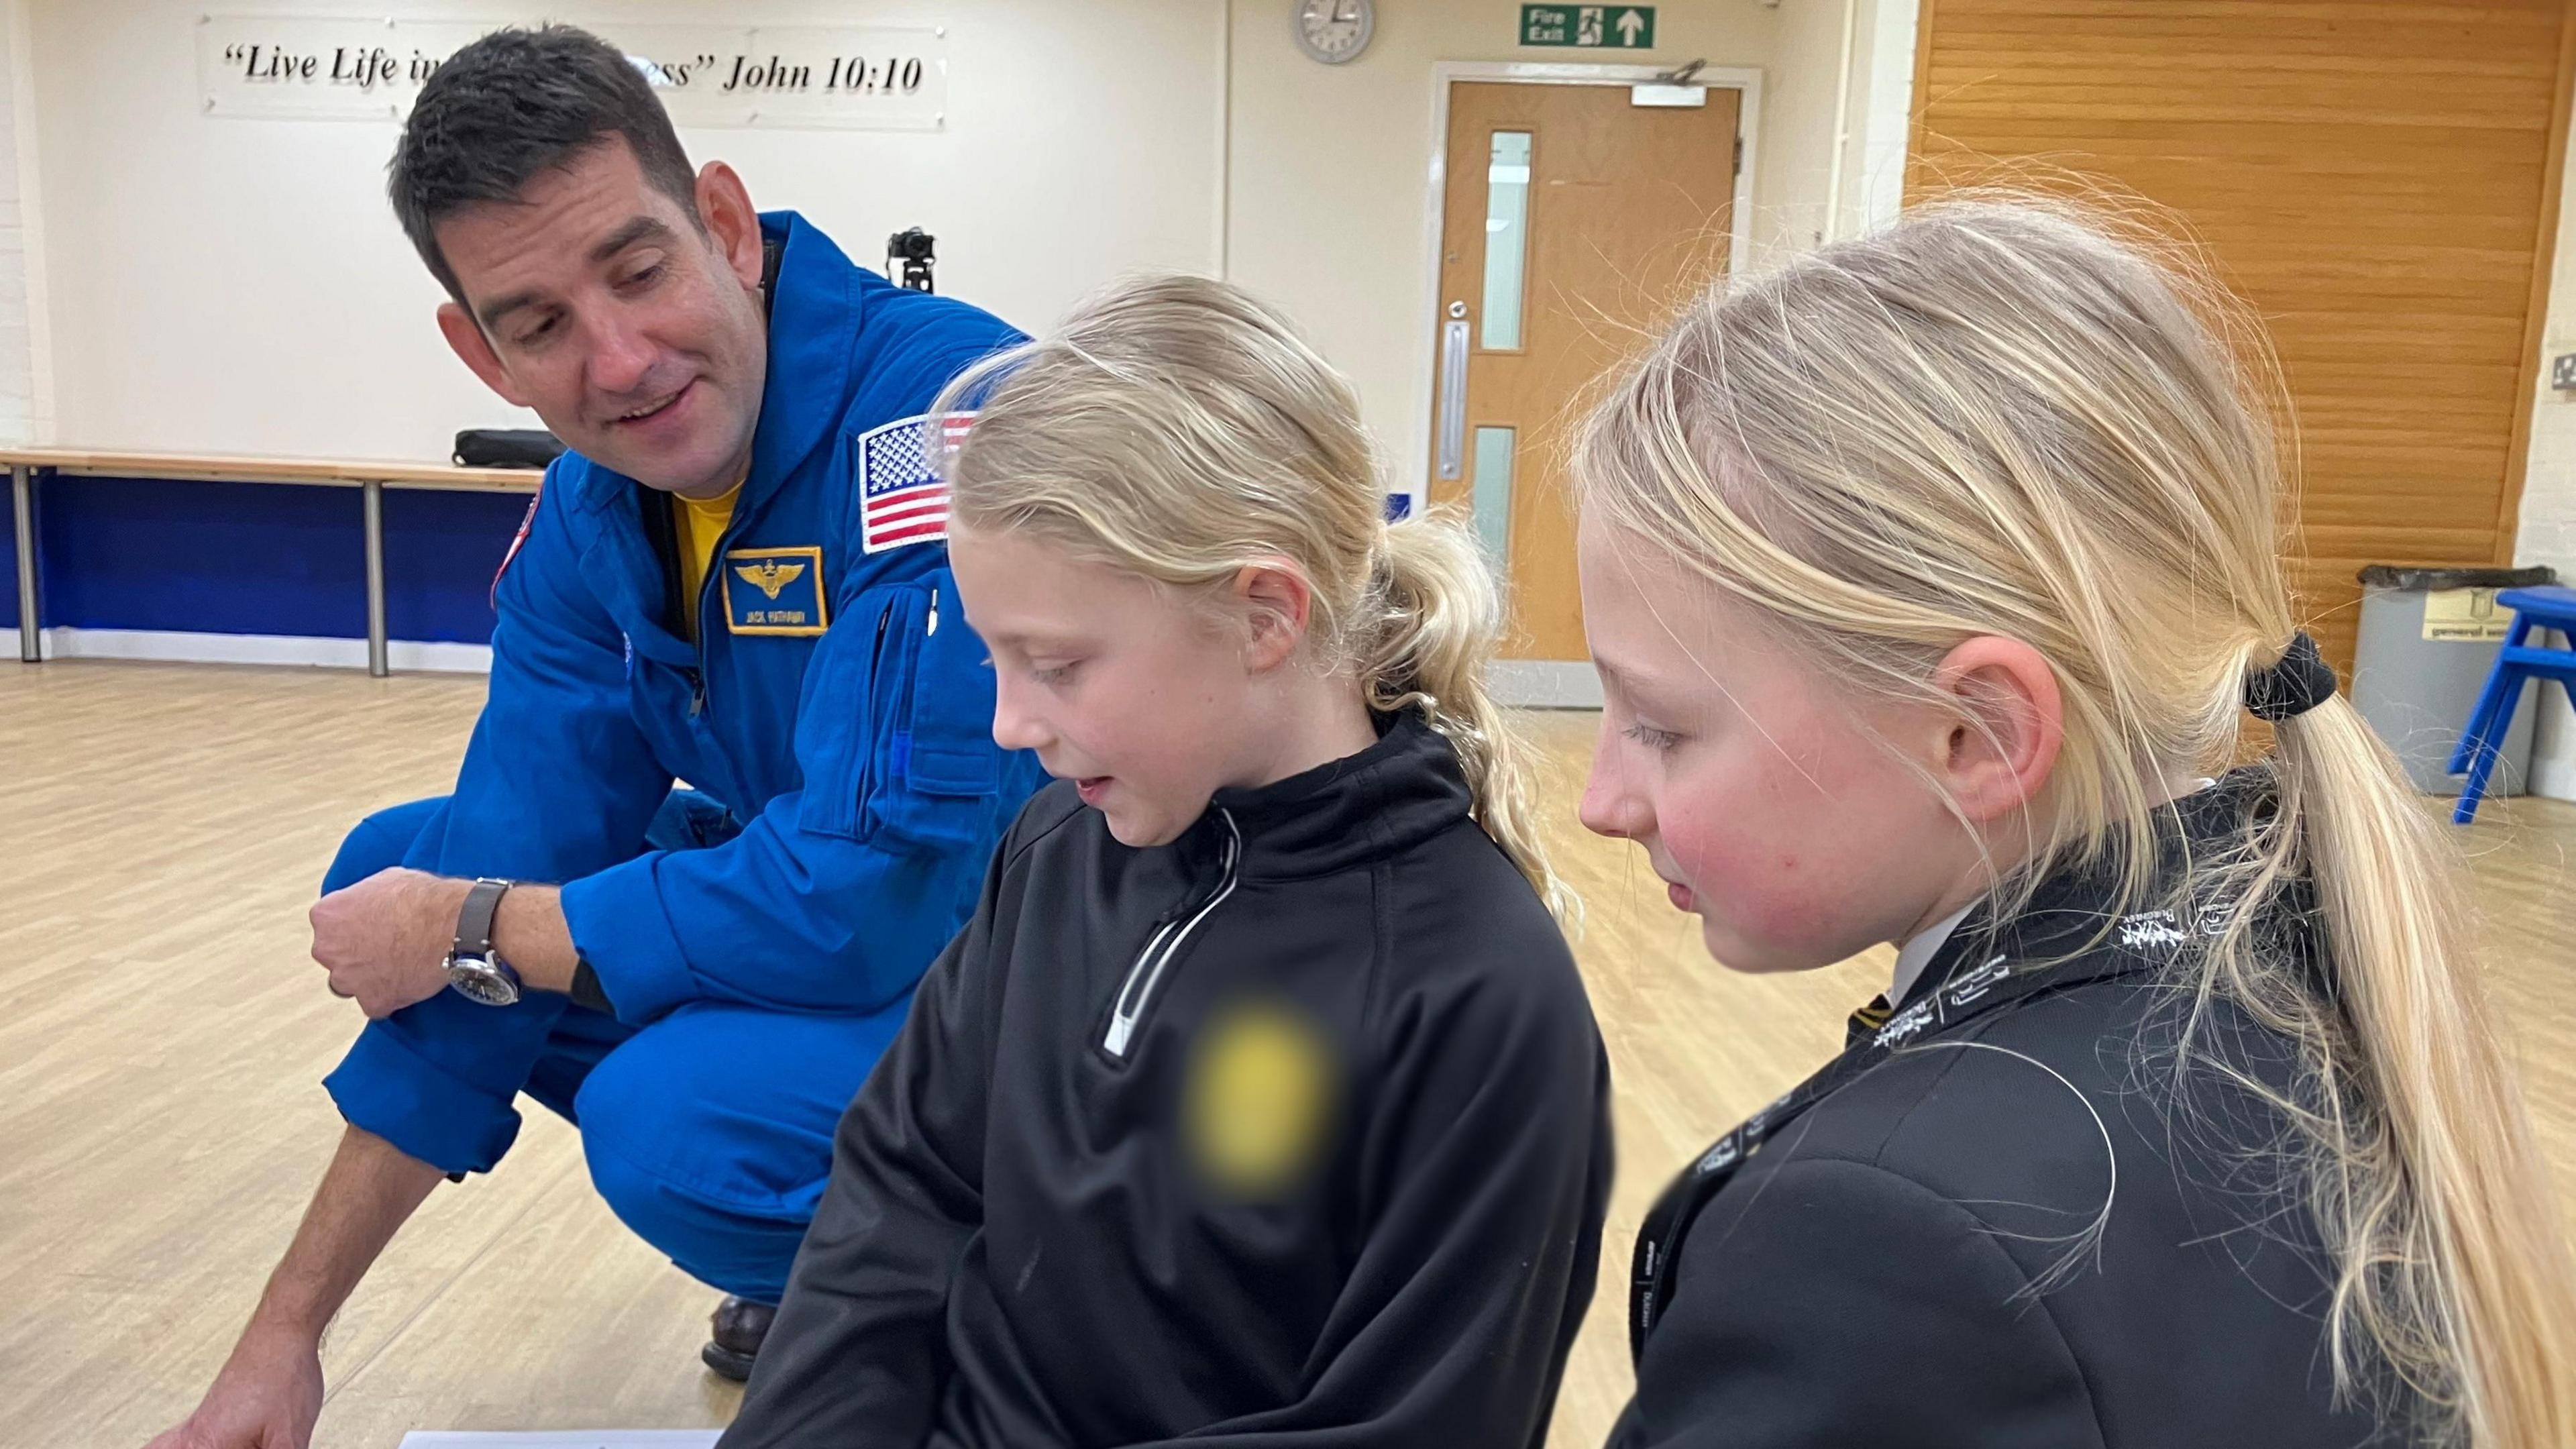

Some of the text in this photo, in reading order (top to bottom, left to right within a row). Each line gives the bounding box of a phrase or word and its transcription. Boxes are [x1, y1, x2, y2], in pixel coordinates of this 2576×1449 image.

[1530, 9, 1565, 25] Fire
[1529, 26, 1564, 40] Exit
[225, 43, 317, 78] “Live
[330, 47, 397, 87] Life
[723, 55, 810, 91] John
[826, 56, 922, 89] 10:10
